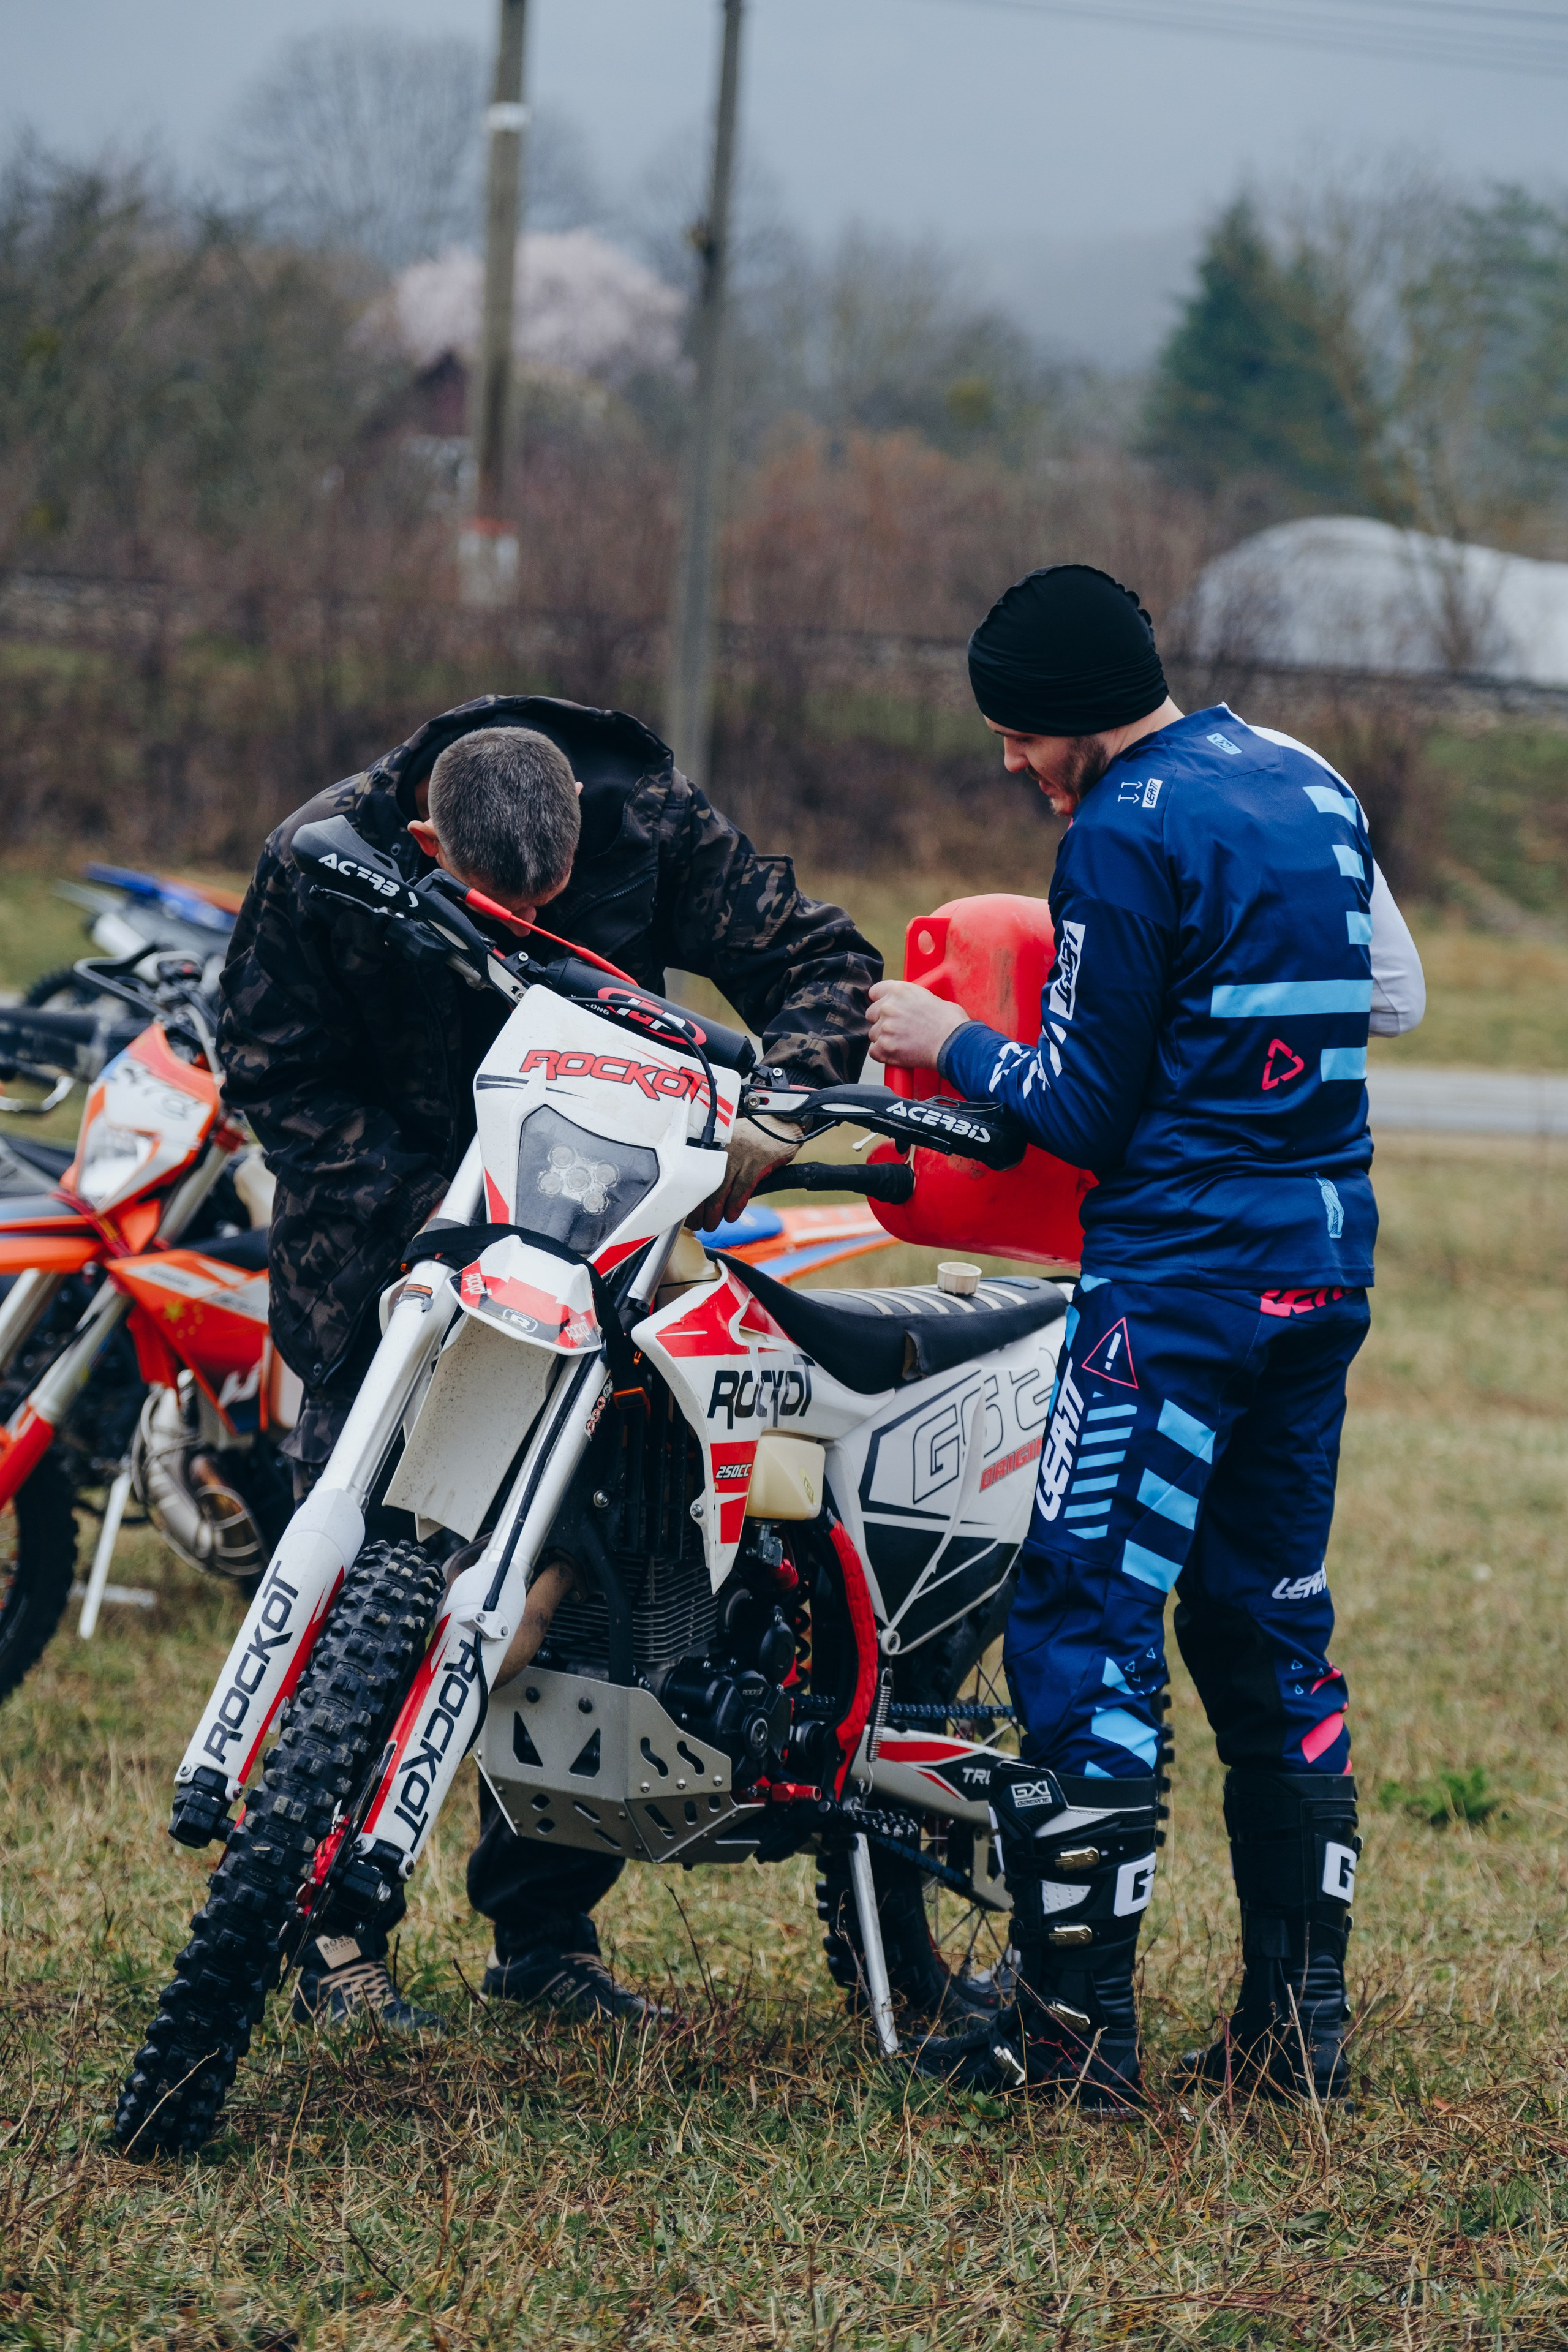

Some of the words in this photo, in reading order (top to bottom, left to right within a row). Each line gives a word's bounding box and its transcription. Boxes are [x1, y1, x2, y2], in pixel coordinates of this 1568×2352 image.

[318, 853, 419, 908] ACERBS
[519, 1049, 718, 1104] ROCKOT
[886, 1101, 991, 1143] ACERBIS
[707, 1354, 816, 1430] ROCKOT
[1036, 1357, 1084, 1521] LEATT
[715, 1463, 752, 1480] 250CC
[203, 1561, 300, 1765] ROCKOT
[393, 1639, 477, 1852] ROCKOT
[1011, 1779, 1051, 1800] GX1
[1113, 1852, 1157, 1917] G
